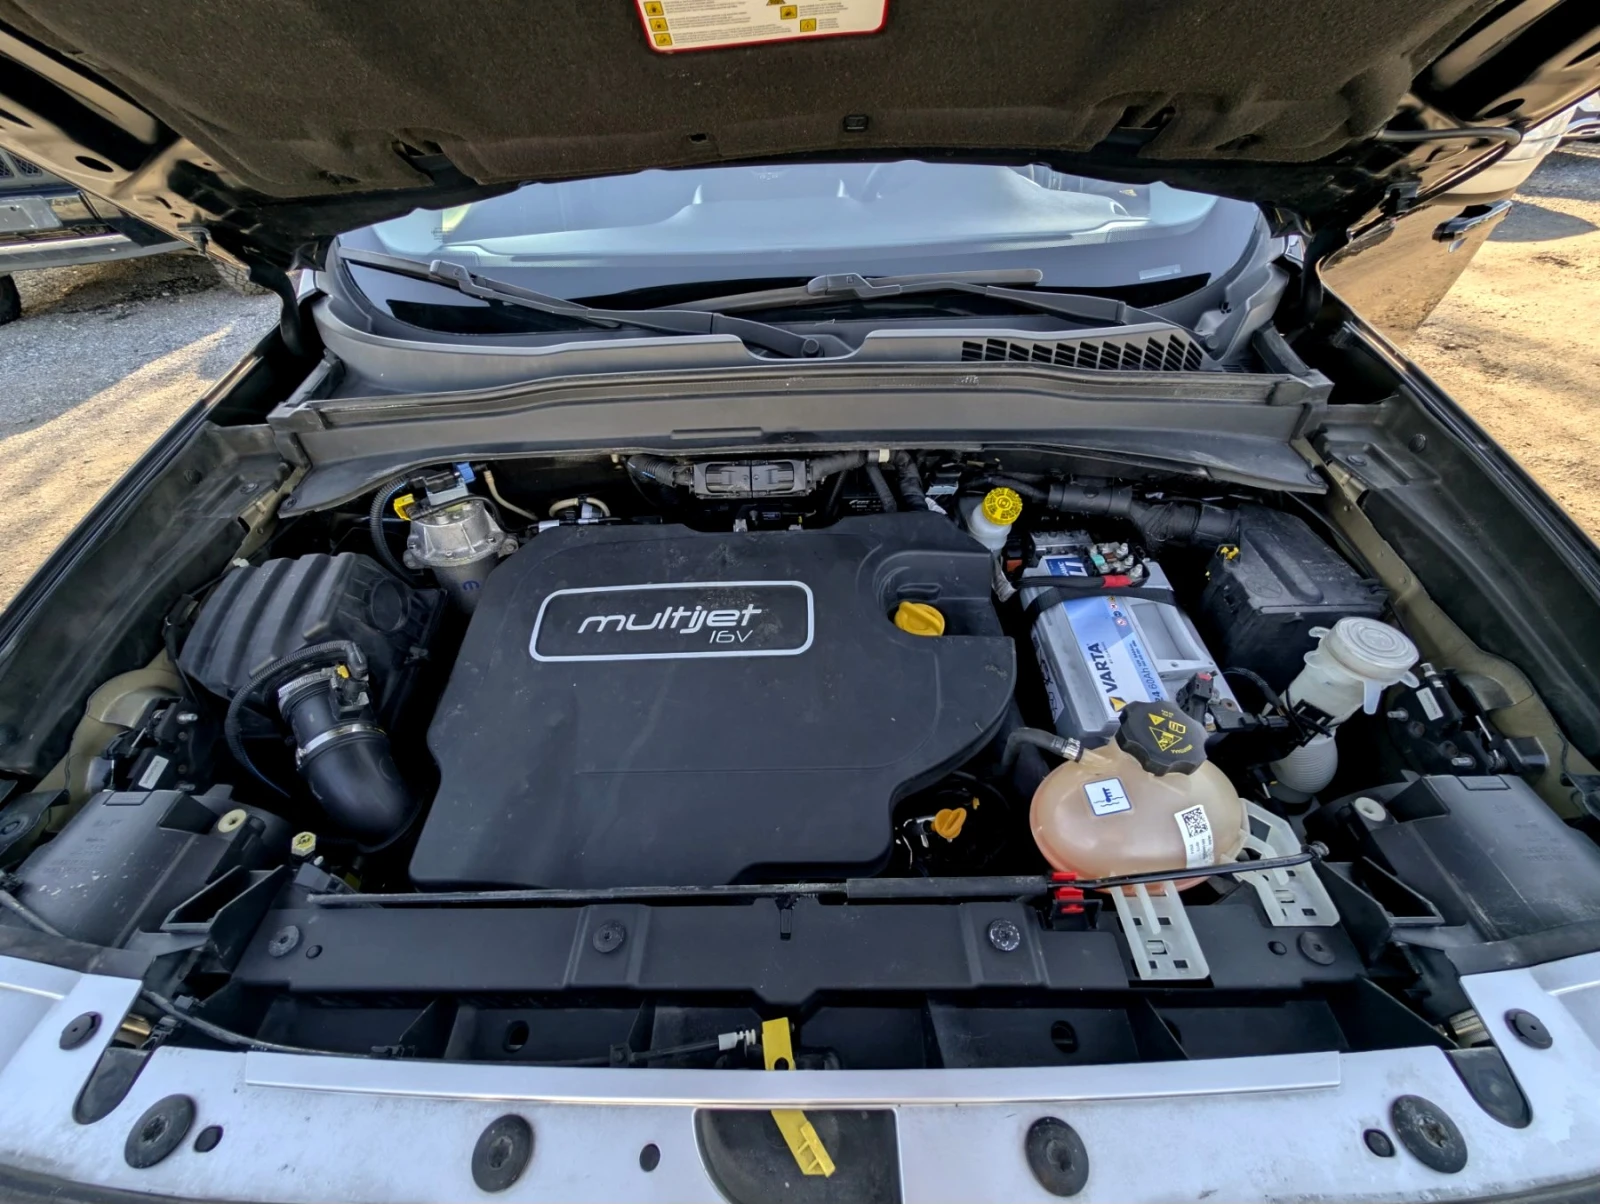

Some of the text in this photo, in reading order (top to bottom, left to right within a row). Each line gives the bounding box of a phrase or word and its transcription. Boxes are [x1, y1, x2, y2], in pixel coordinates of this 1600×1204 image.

[577, 603, 762, 634] multijet
[709, 629, 753, 643] 16V
[1088, 643, 1118, 693] VARTA
[1141, 667, 1158, 689] 60Ah
